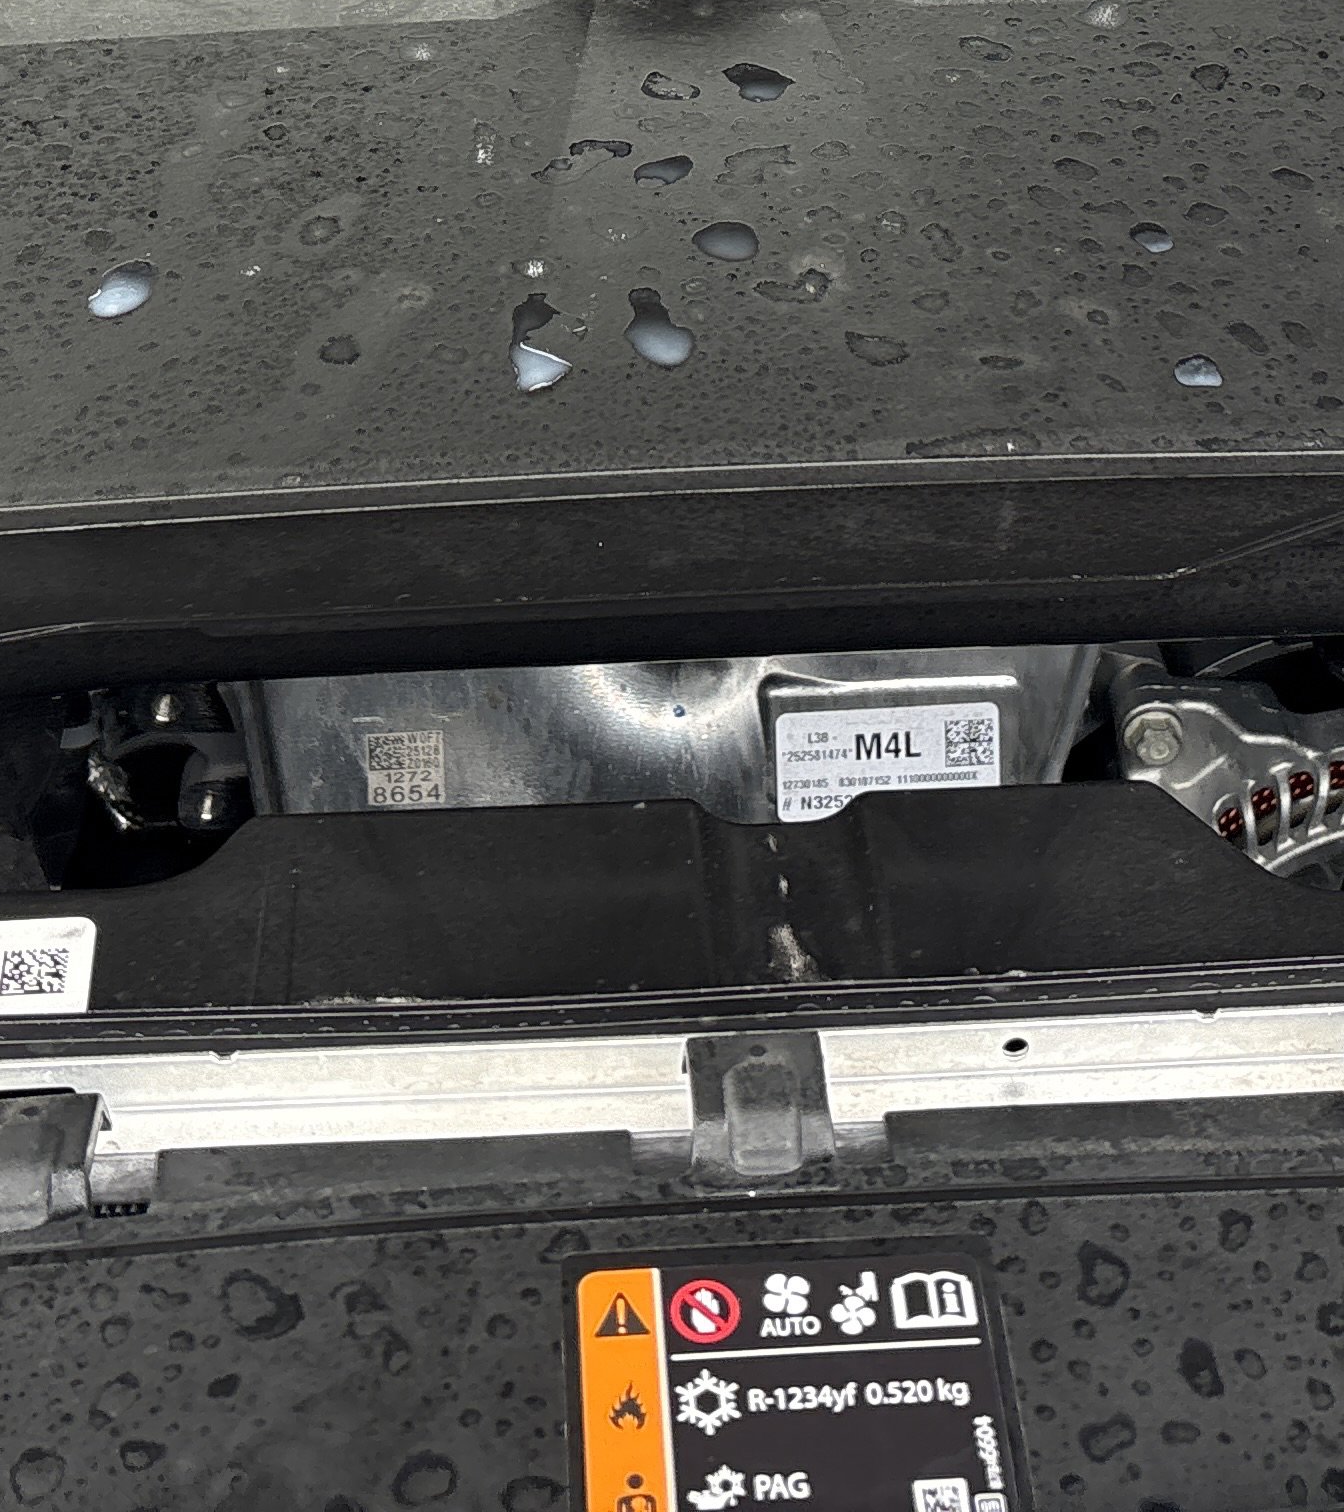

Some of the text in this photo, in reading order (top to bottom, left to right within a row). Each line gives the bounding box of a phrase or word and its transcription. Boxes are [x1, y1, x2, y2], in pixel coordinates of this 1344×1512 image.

[855, 731, 922, 761] M4L
[384, 770, 432, 784] 1272
[373, 783, 441, 804] 8654
[760, 1316, 821, 1337] AUTO
[747, 1376, 971, 1413] R-1234yf 0.520 kg
[753, 1471, 811, 1500] PAG
